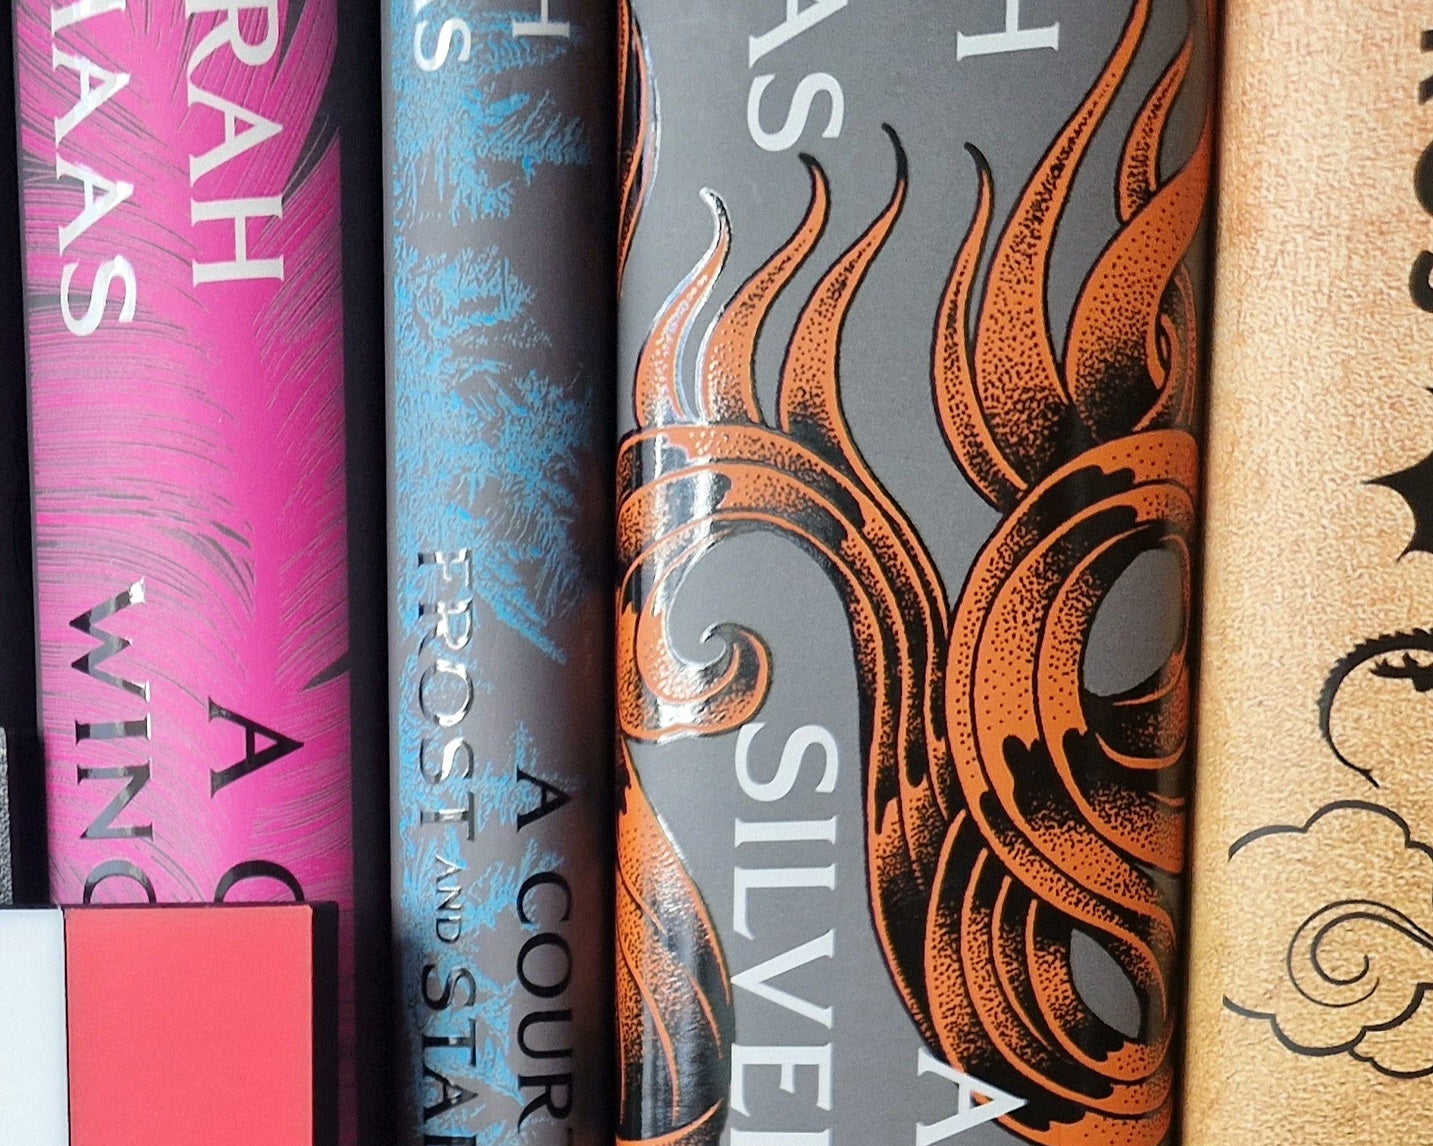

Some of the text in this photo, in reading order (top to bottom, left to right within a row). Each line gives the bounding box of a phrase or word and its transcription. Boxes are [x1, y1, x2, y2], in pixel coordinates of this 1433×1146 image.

[68, 576, 157, 902] WIN
[418, 548, 475, 843] FROST
[208, 696, 304, 799] A
[516, 766, 572, 833] A
[433, 854, 464, 945] AND
